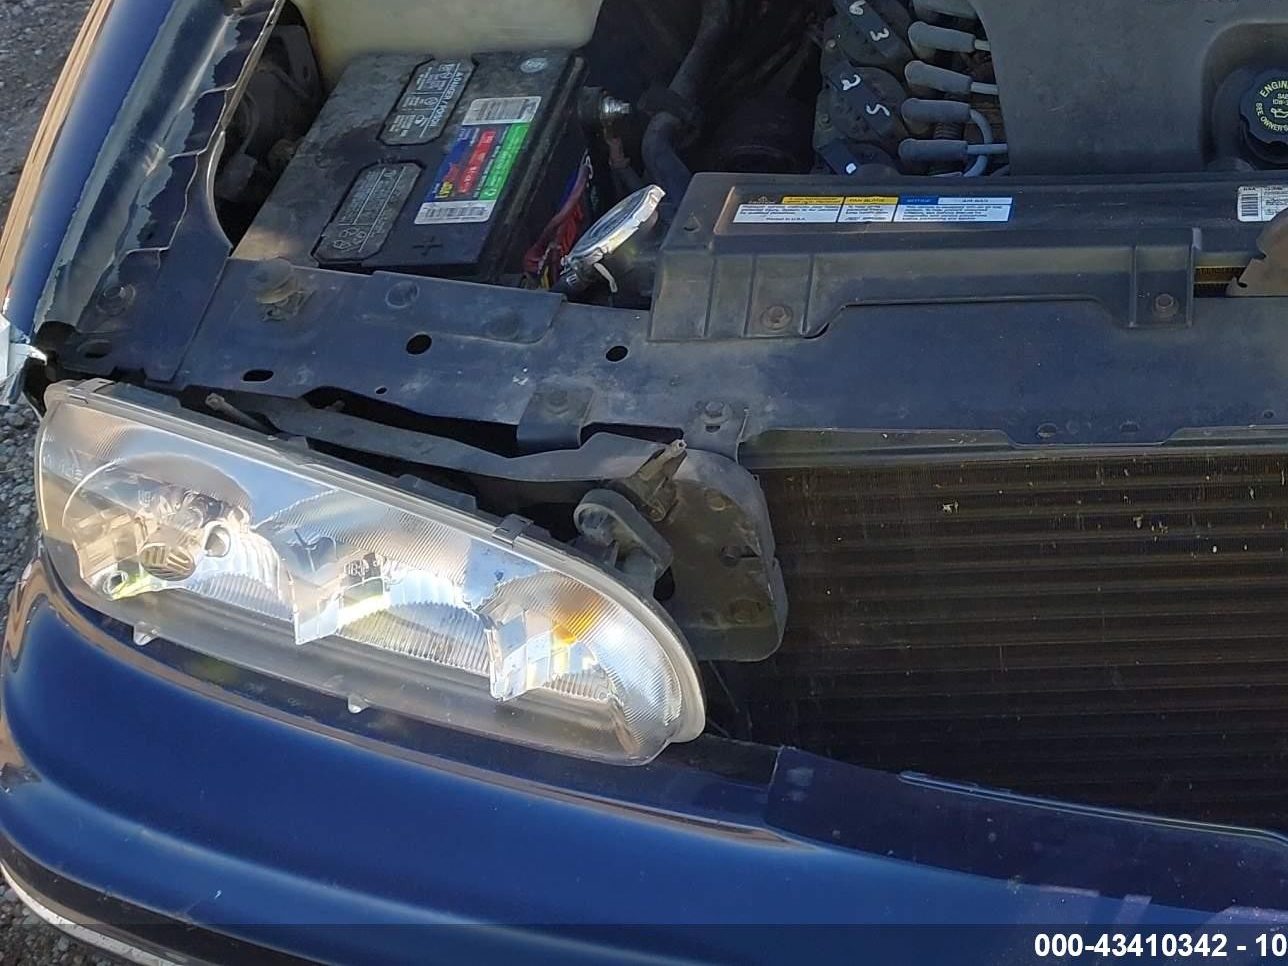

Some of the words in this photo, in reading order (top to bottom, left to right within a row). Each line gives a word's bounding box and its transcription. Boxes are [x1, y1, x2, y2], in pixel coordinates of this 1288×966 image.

[848, 0, 867, 16] 6
[869, 27, 890, 42] 3
[840, 73, 862, 91] 2
[866, 103, 891, 117] 5
[1255, 102, 1264, 116] SEE
